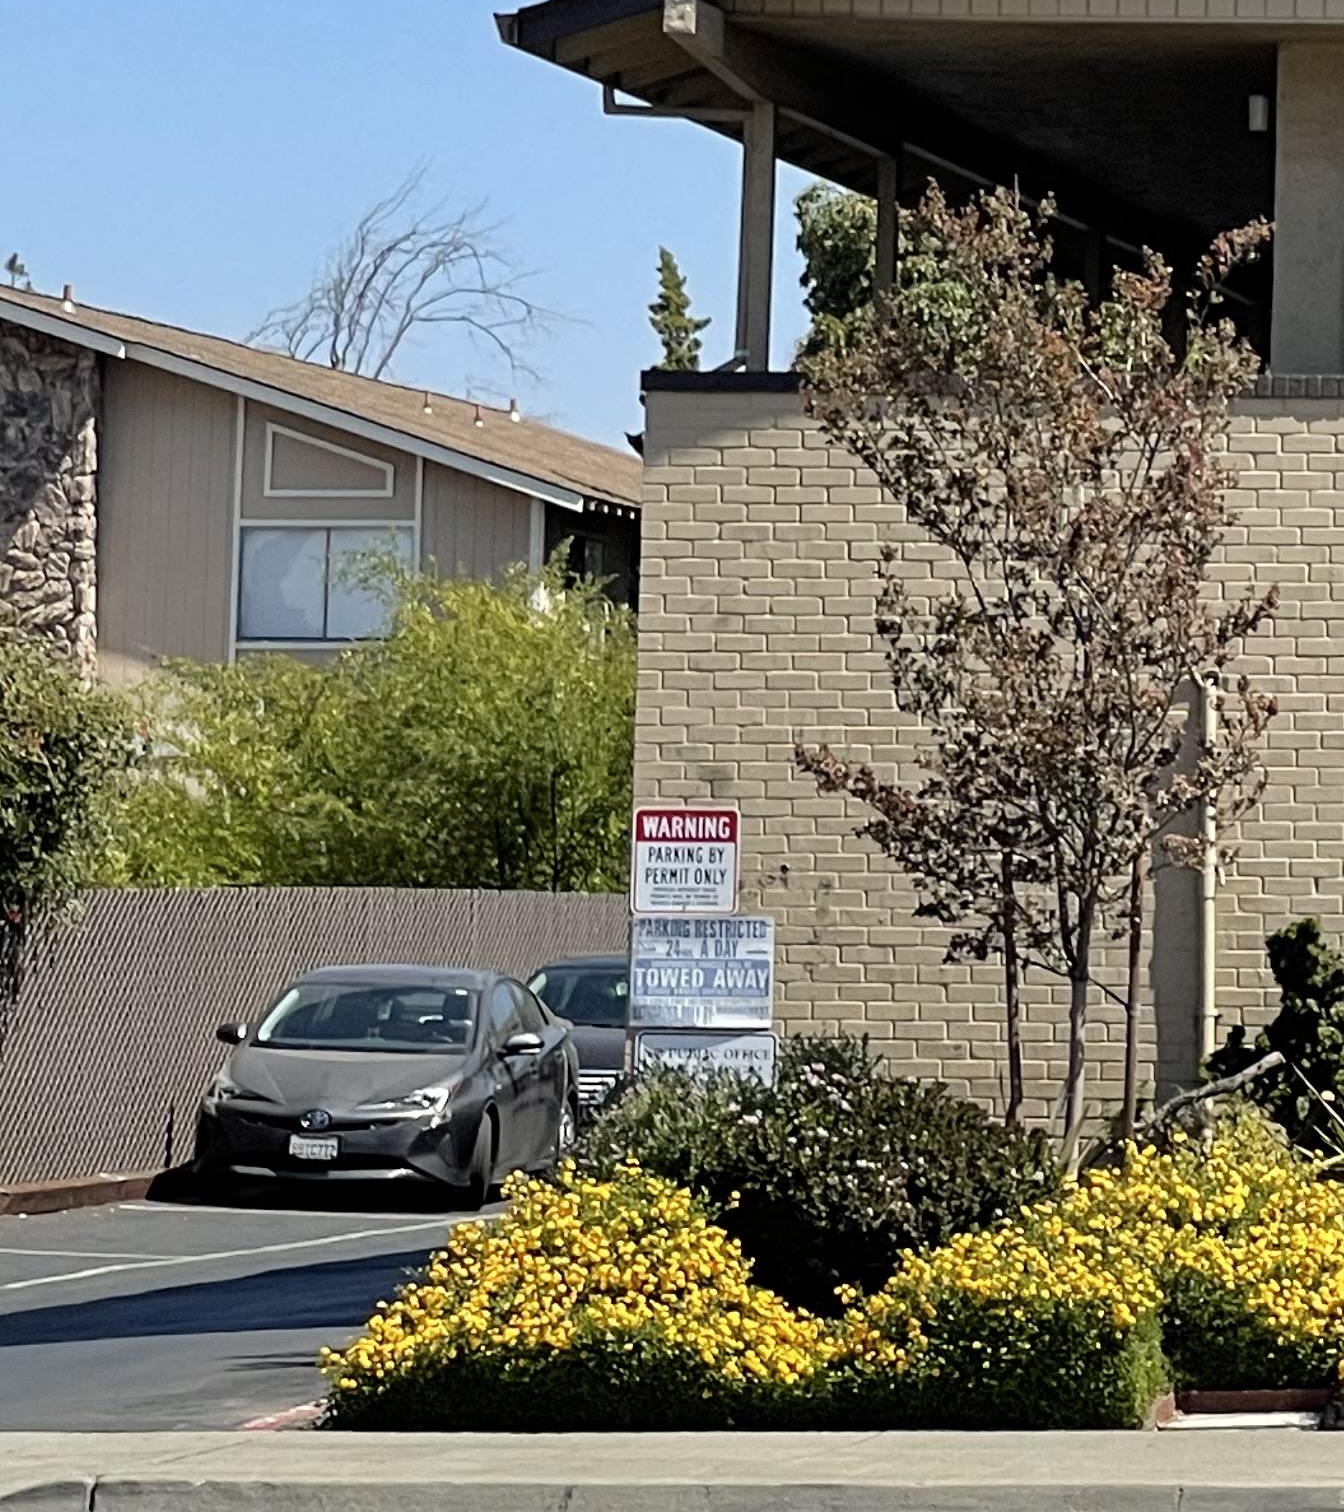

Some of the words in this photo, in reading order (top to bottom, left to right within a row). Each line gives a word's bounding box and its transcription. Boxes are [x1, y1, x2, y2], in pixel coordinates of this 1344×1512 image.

[642, 815, 731, 839] WARNING
[648, 847, 703, 863] PARKING
[709, 847, 724, 863] BY
[645, 868, 689, 884] PERMIT
[694, 868, 727, 885] ONLY
[639, 919, 690, 937] PARKING
[694, 919, 767, 938] RESTRICTED
[701, 939, 709, 957] A
[715, 940, 739, 958] DAY
[635, 968, 704, 988] TOWED
[713, 968, 769, 989] AWAY
[724, 1049, 771, 1061] OFFICE
